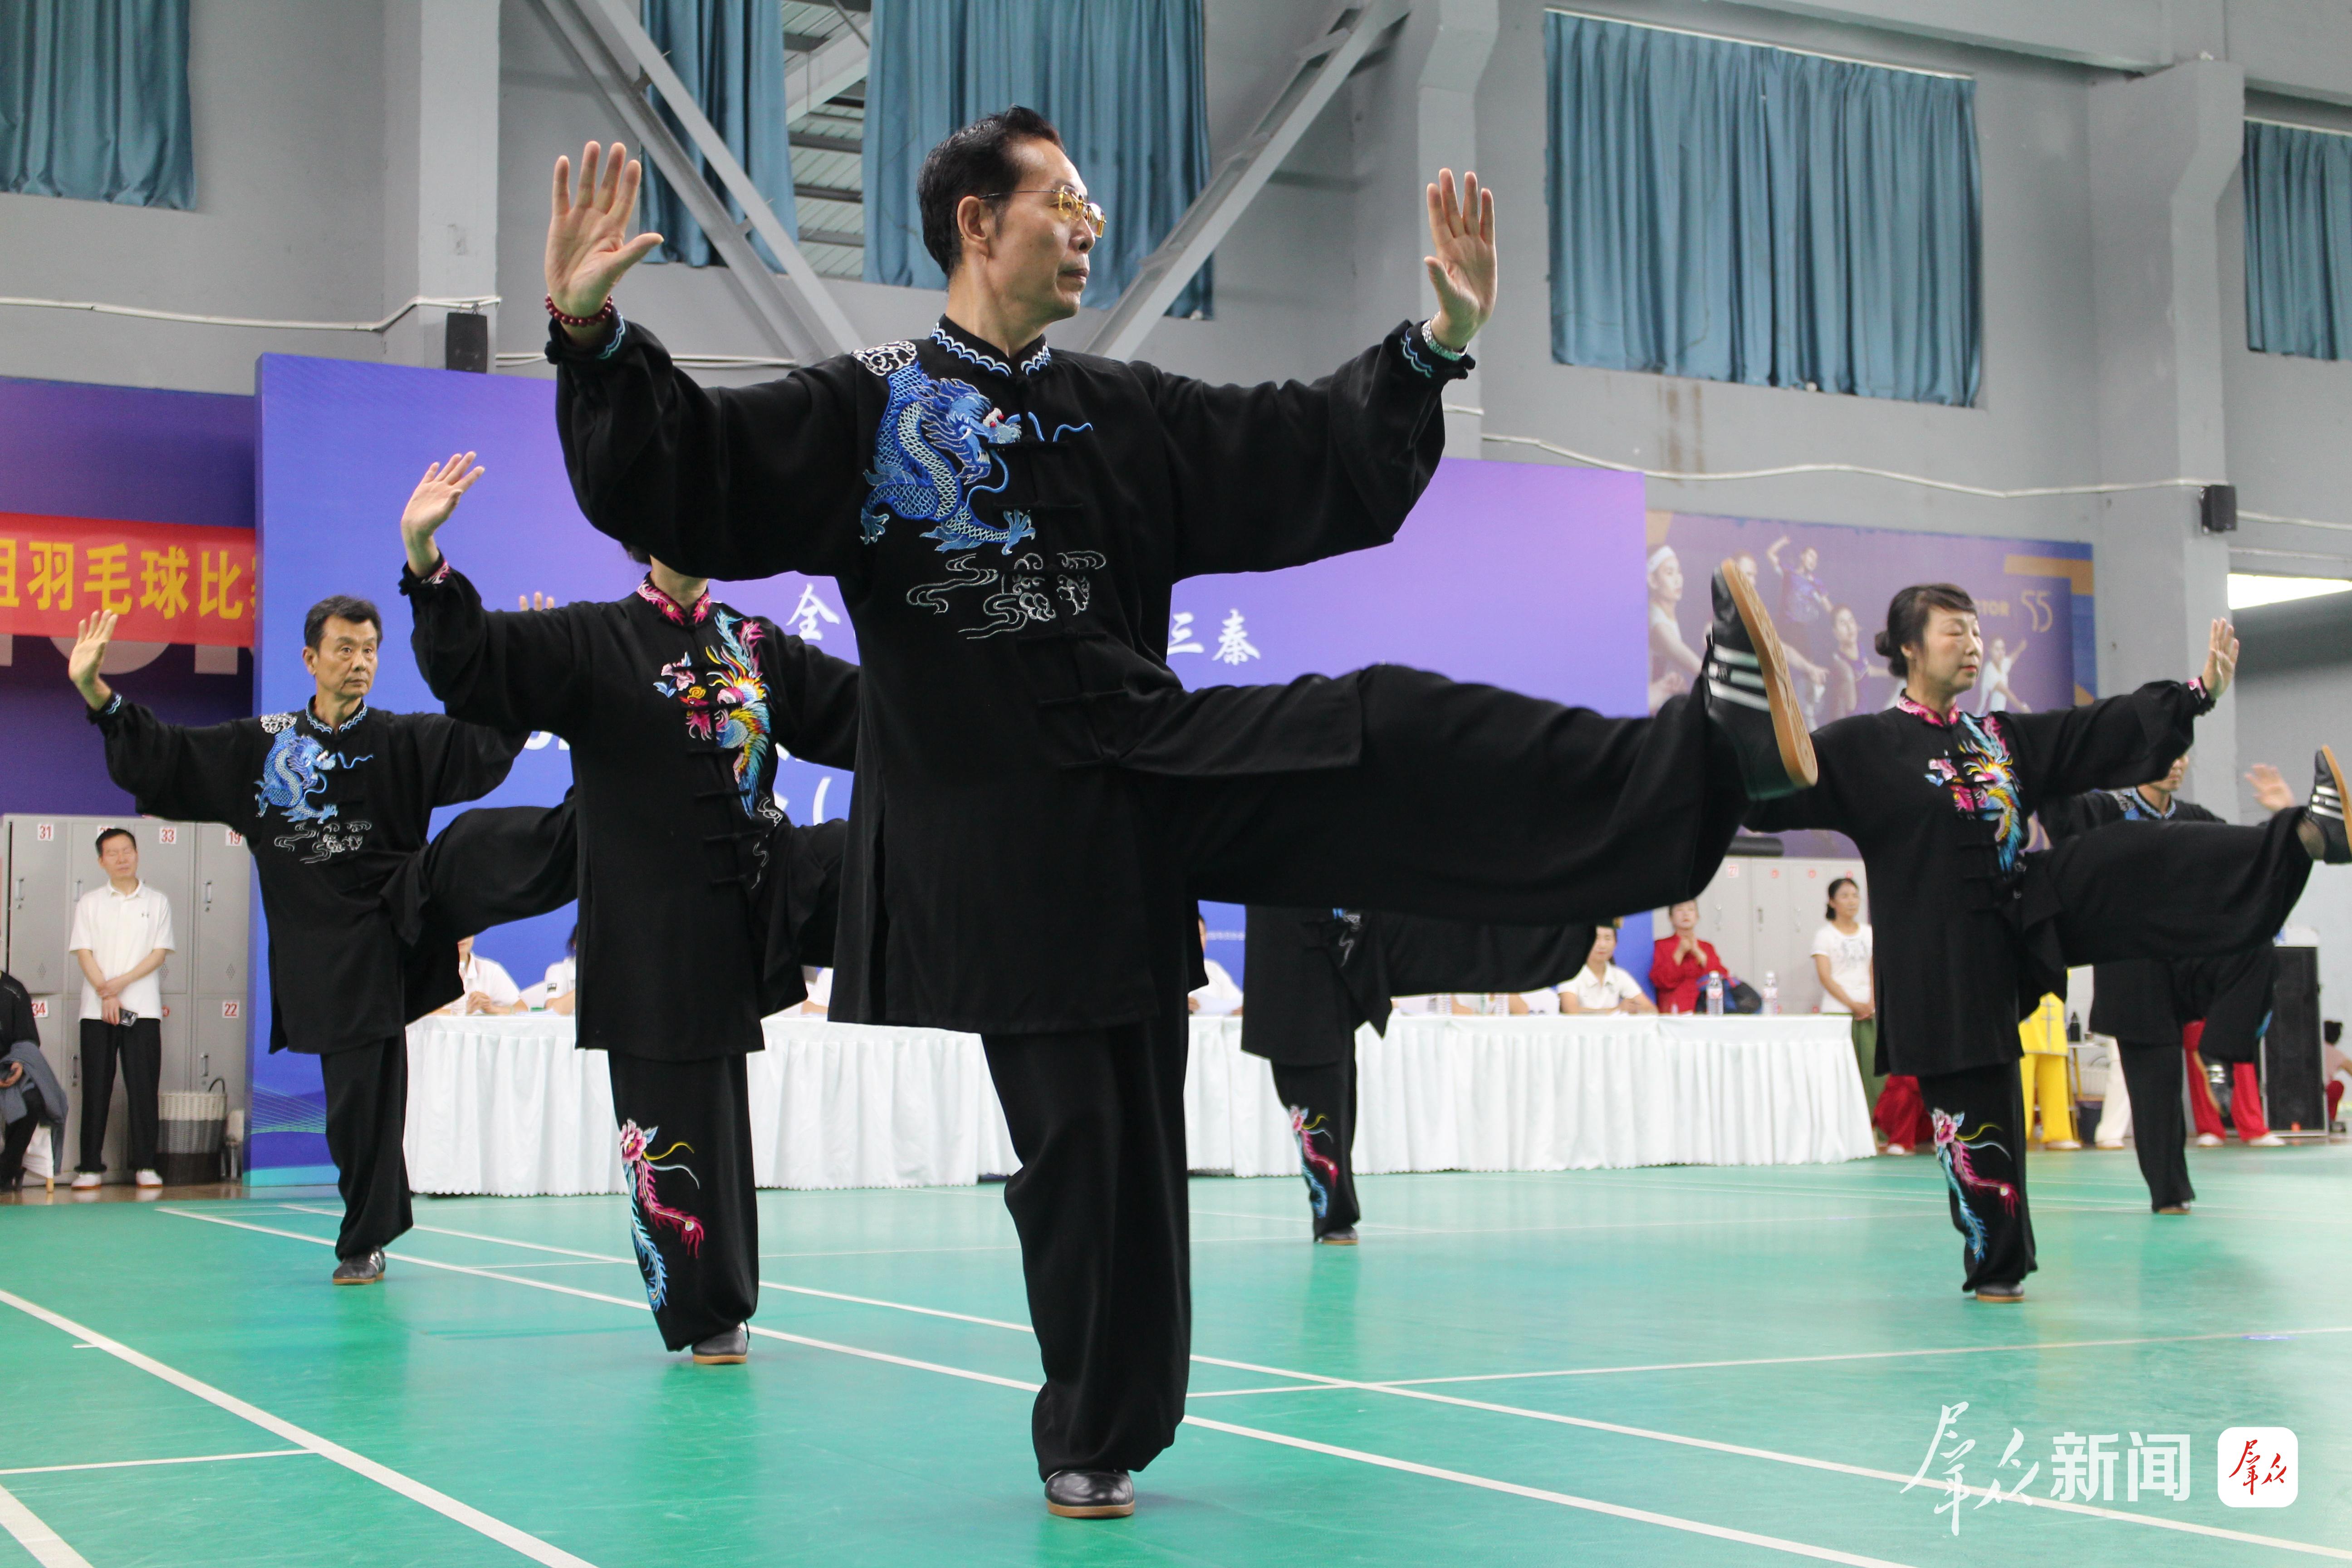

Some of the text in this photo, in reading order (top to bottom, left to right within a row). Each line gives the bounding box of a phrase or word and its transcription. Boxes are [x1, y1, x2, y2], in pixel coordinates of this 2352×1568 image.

[1166, 608, 1260, 666] 三秦
[39, 825, 52, 839] 31
[161, 828, 175, 843] 33
[229, 830, 241, 844] 19
[32, 1002, 46, 1017] 34
[224, 1003, 237, 1017] 22
